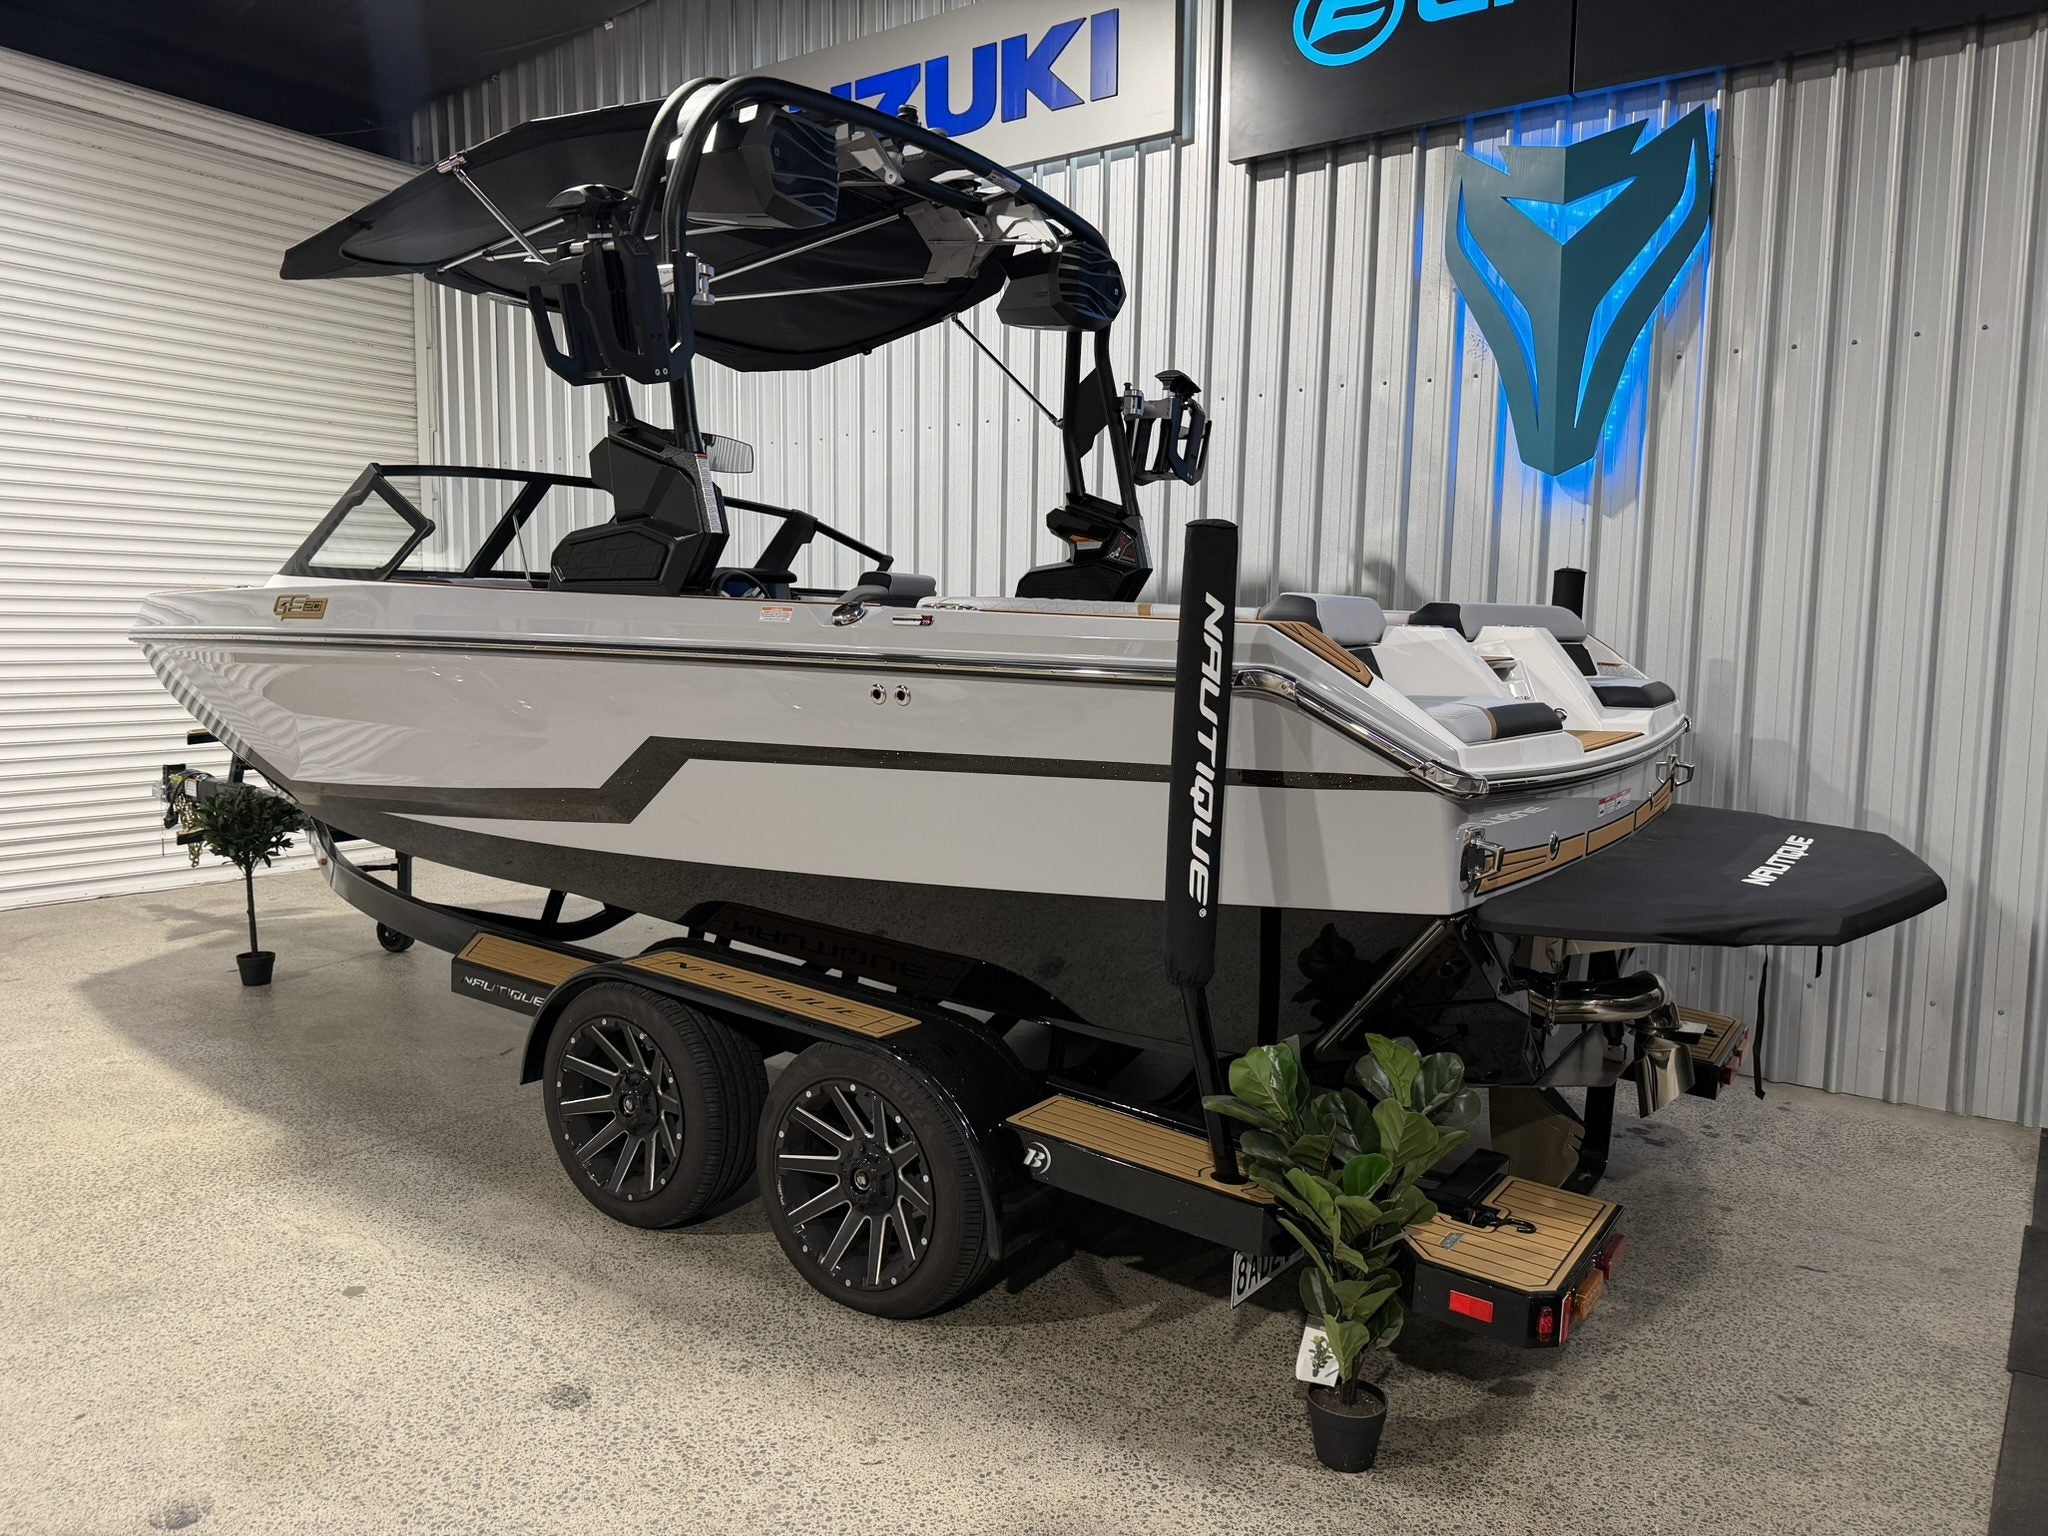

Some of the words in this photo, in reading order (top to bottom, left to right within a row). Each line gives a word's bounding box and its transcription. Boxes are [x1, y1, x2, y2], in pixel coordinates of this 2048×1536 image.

[789, 8, 1118, 138] ZUKI
[1741, 834, 1814, 887] NAUTIQUE
[463, 976, 545, 1007] NAUTIQUE
[666, 960, 875, 1019] NAUTIQUE
